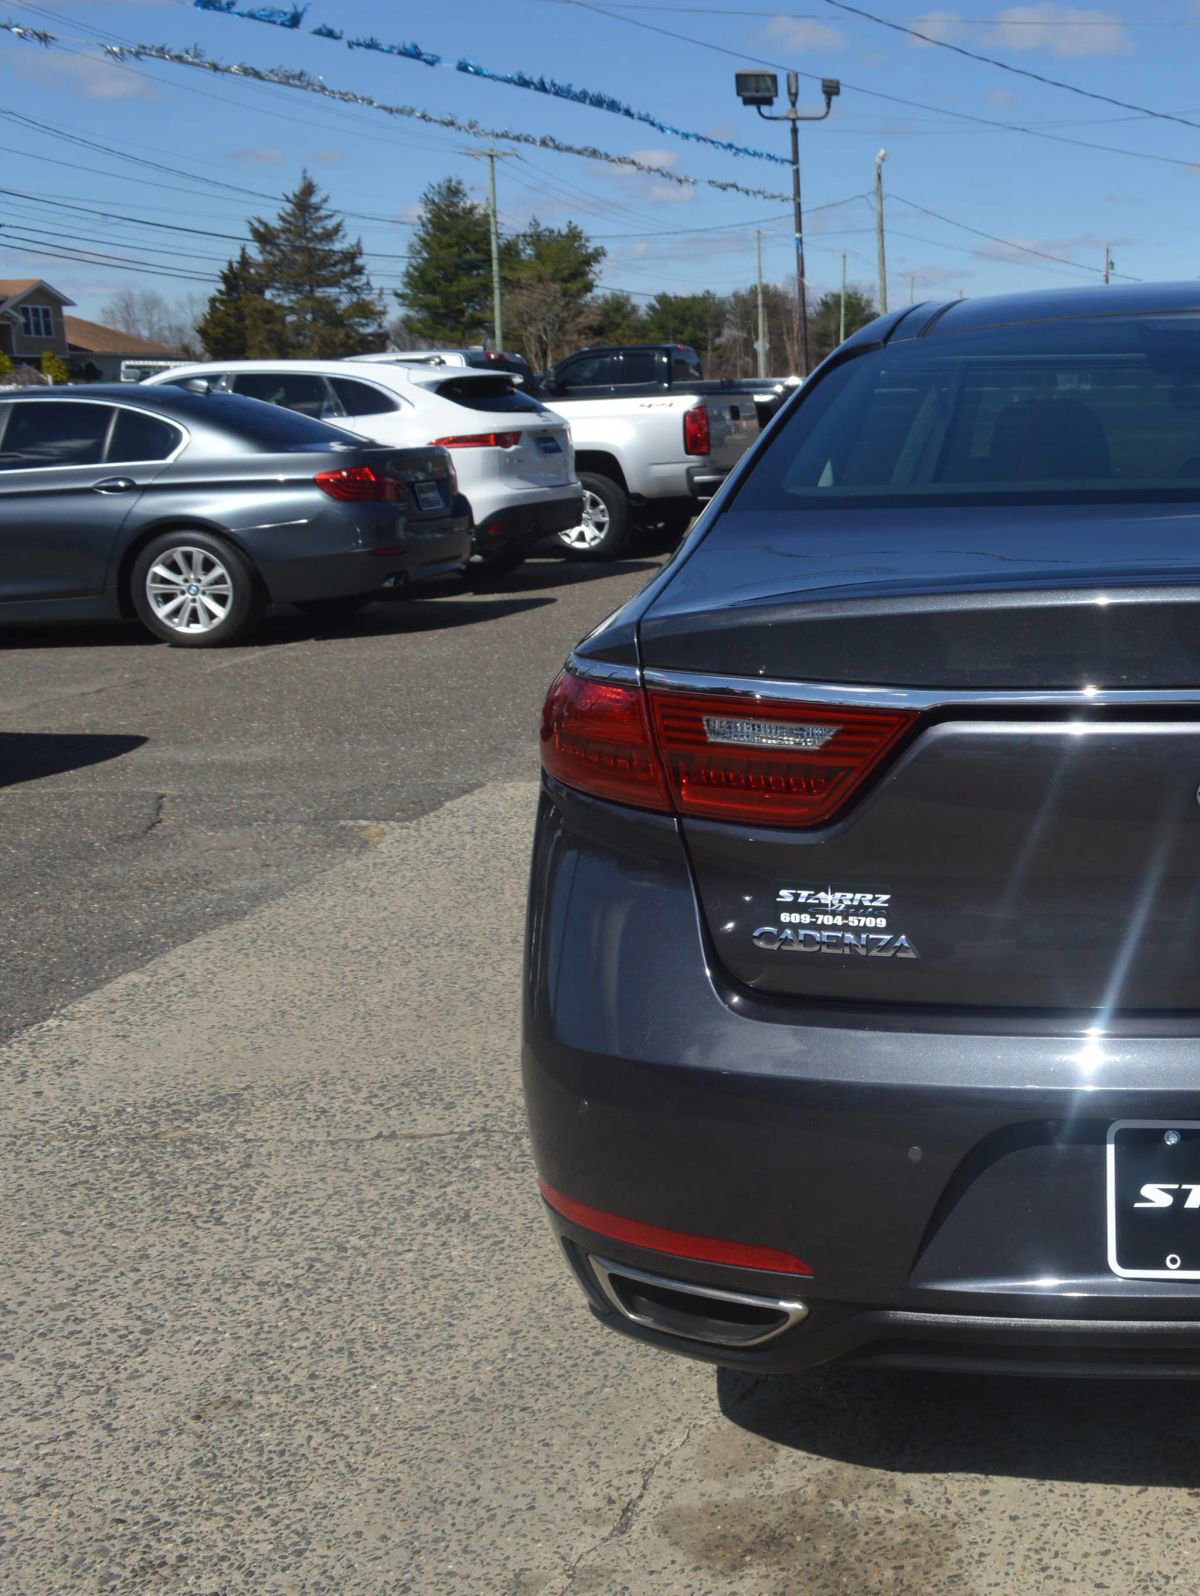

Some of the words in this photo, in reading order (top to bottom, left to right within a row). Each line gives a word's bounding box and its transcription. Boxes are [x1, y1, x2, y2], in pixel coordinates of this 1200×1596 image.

[776, 889, 891, 906] STARRZ
[780, 912, 887, 927] 609-704-5709
[752, 926, 919, 959] CADENZA
